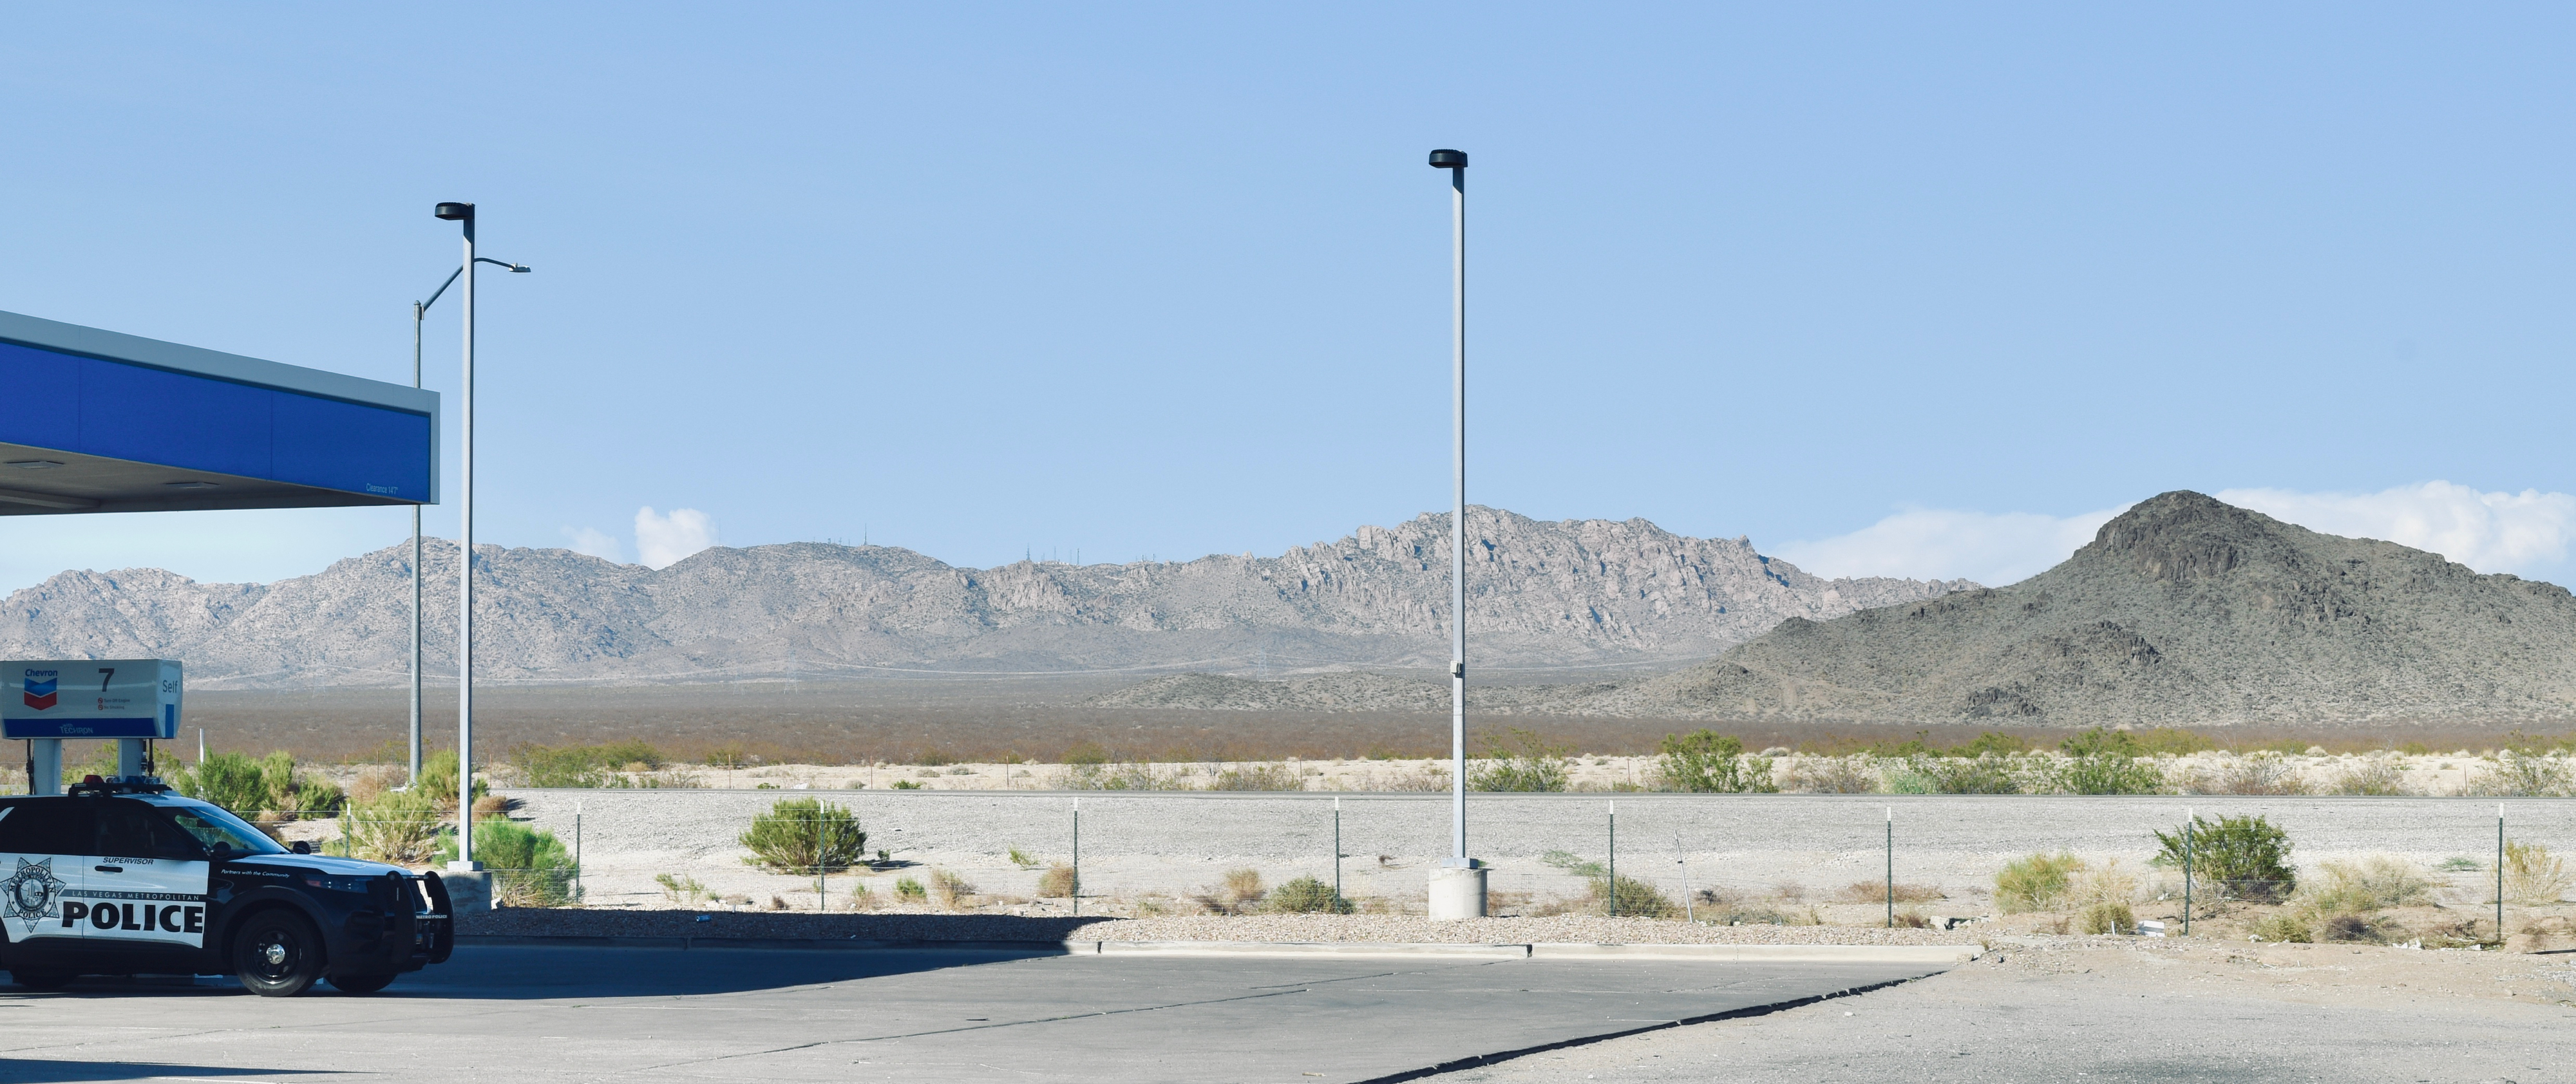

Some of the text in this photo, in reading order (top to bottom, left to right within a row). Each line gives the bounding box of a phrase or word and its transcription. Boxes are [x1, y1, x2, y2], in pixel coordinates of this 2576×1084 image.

[366, 483, 387, 493] Clearance
[99, 668, 115, 692] 7
[162, 679, 178, 693] Self
[59, 726, 93, 735] TECHRON
[103, 857, 154, 865] SUPERVISOR
[9, 866, 55, 893] METROPOLITAN
[128, 893, 200, 901] METROPOLITAN
[17, 908, 47, 919] POLICE
[61, 901, 204, 933] POLICE
